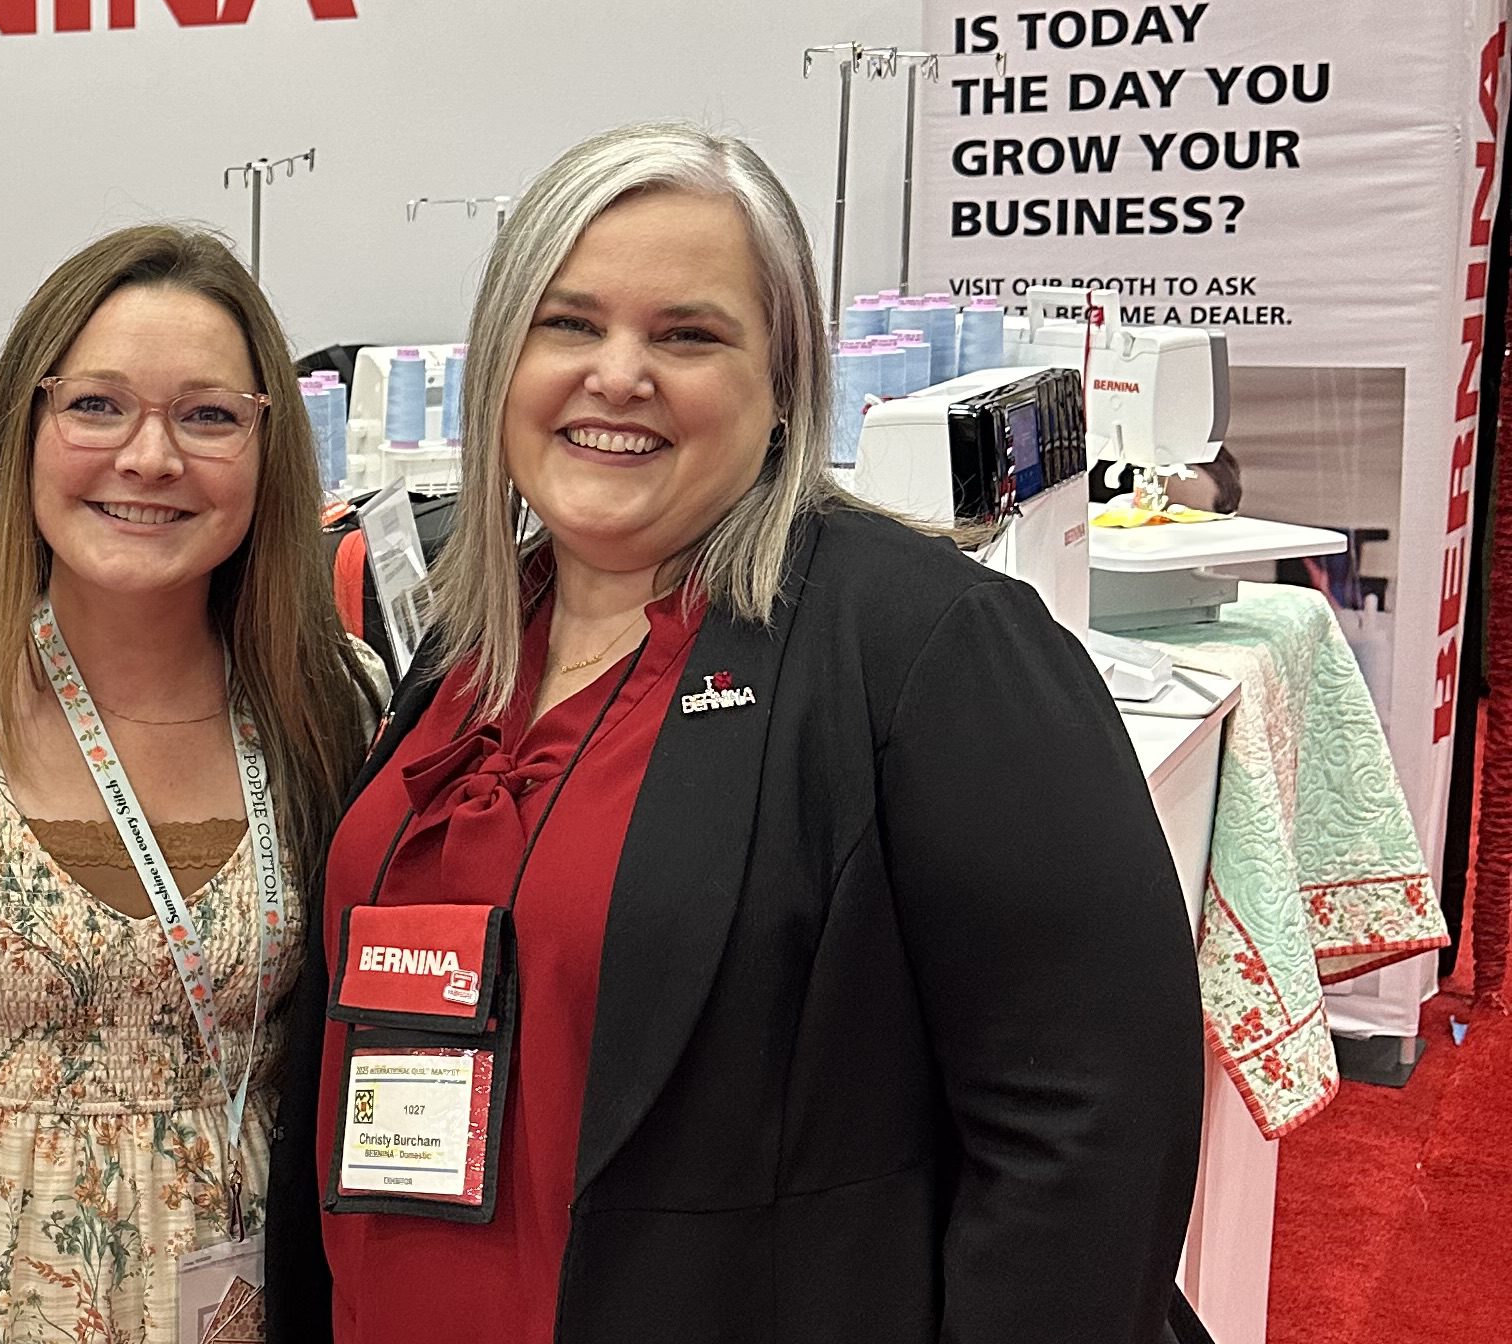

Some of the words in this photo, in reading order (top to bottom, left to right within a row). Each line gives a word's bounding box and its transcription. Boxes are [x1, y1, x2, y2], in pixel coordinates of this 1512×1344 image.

[954, 14, 999, 55] IS
[1017, 2, 1209, 51] TODAY
[952, 74, 1049, 117] THE
[1069, 69, 1186, 112] DAY
[1205, 62, 1331, 106] YOU
[951, 134, 1121, 177] GROW
[1140, 129, 1301, 172] YOUR
[951, 195, 1246, 238] BUSINESS?
[949, 278, 1005, 297] VISIT
[1163, 277, 1198, 296] TO
[1205, 276, 1257, 296] ASK
[1055, 305, 1155, 324] BECME
[1163, 307, 1182, 324] A
[1190, 305, 1293, 326] DEALER.
[1093, 379, 1140, 394] BERNINA
[1432, 20, 1508, 744] BERNINA
[681, 686, 757, 714] BERNINA
[105, 778, 131, 816] Stitch
[243, 753, 268, 818] POPPIE
[257, 822, 279, 905] COTTON
[143, 853, 156, 866] in
[149, 866, 181, 925] Sunshine
[358, 945, 460, 977] BERNINA
[403, 1105, 426, 1116] 1027
[359, 1132, 392, 1148] Christy
[393, 1134, 441, 1148] Burcham
